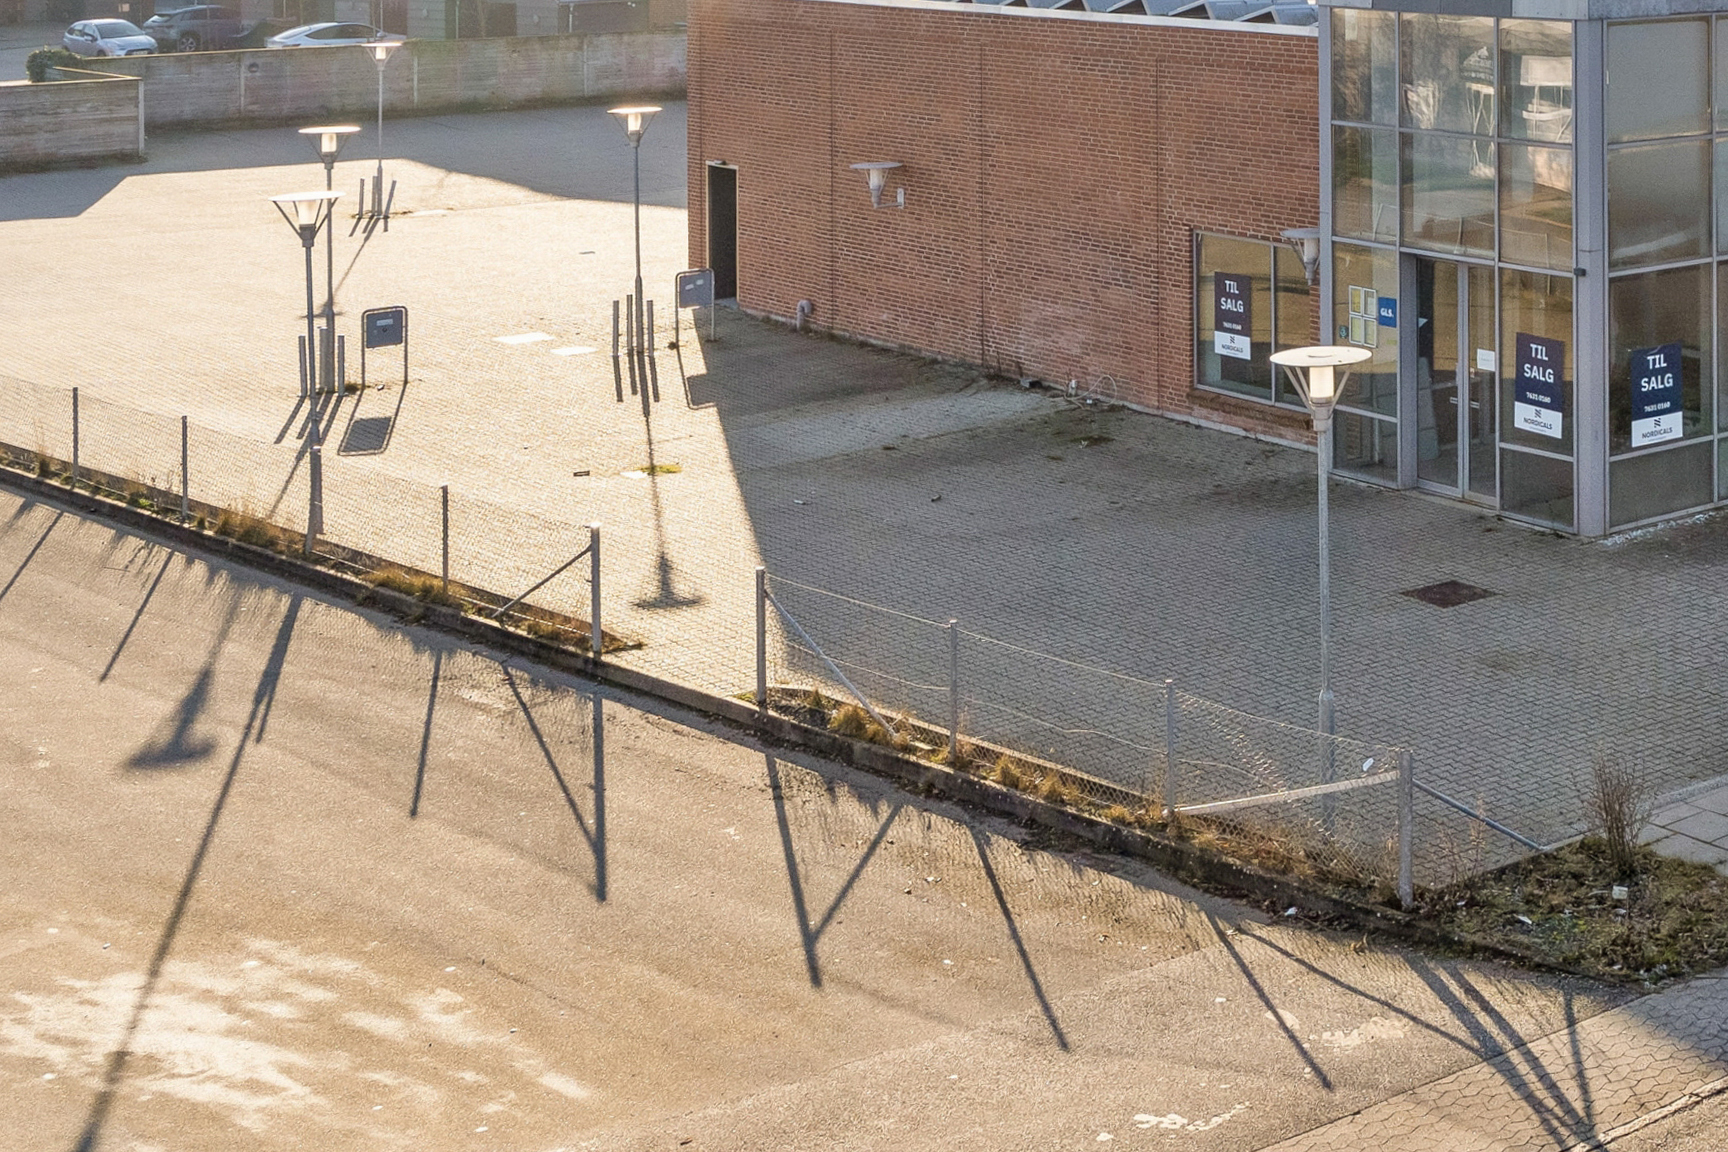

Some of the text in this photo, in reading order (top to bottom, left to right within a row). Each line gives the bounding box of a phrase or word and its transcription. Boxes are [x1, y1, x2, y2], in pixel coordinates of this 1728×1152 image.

[1225, 280, 1239, 294] TIL
[1220, 297, 1244, 313] SALG
[1530, 343, 1549, 361] TIL
[1647, 353, 1667, 370] TIL
[1523, 363, 1554, 383] SALG
[1641, 373, 1673, 392] SALG
[1523, 417, 1553, 430] NORDICALS
[1641, 427, 1673, 439] NORDICALS
